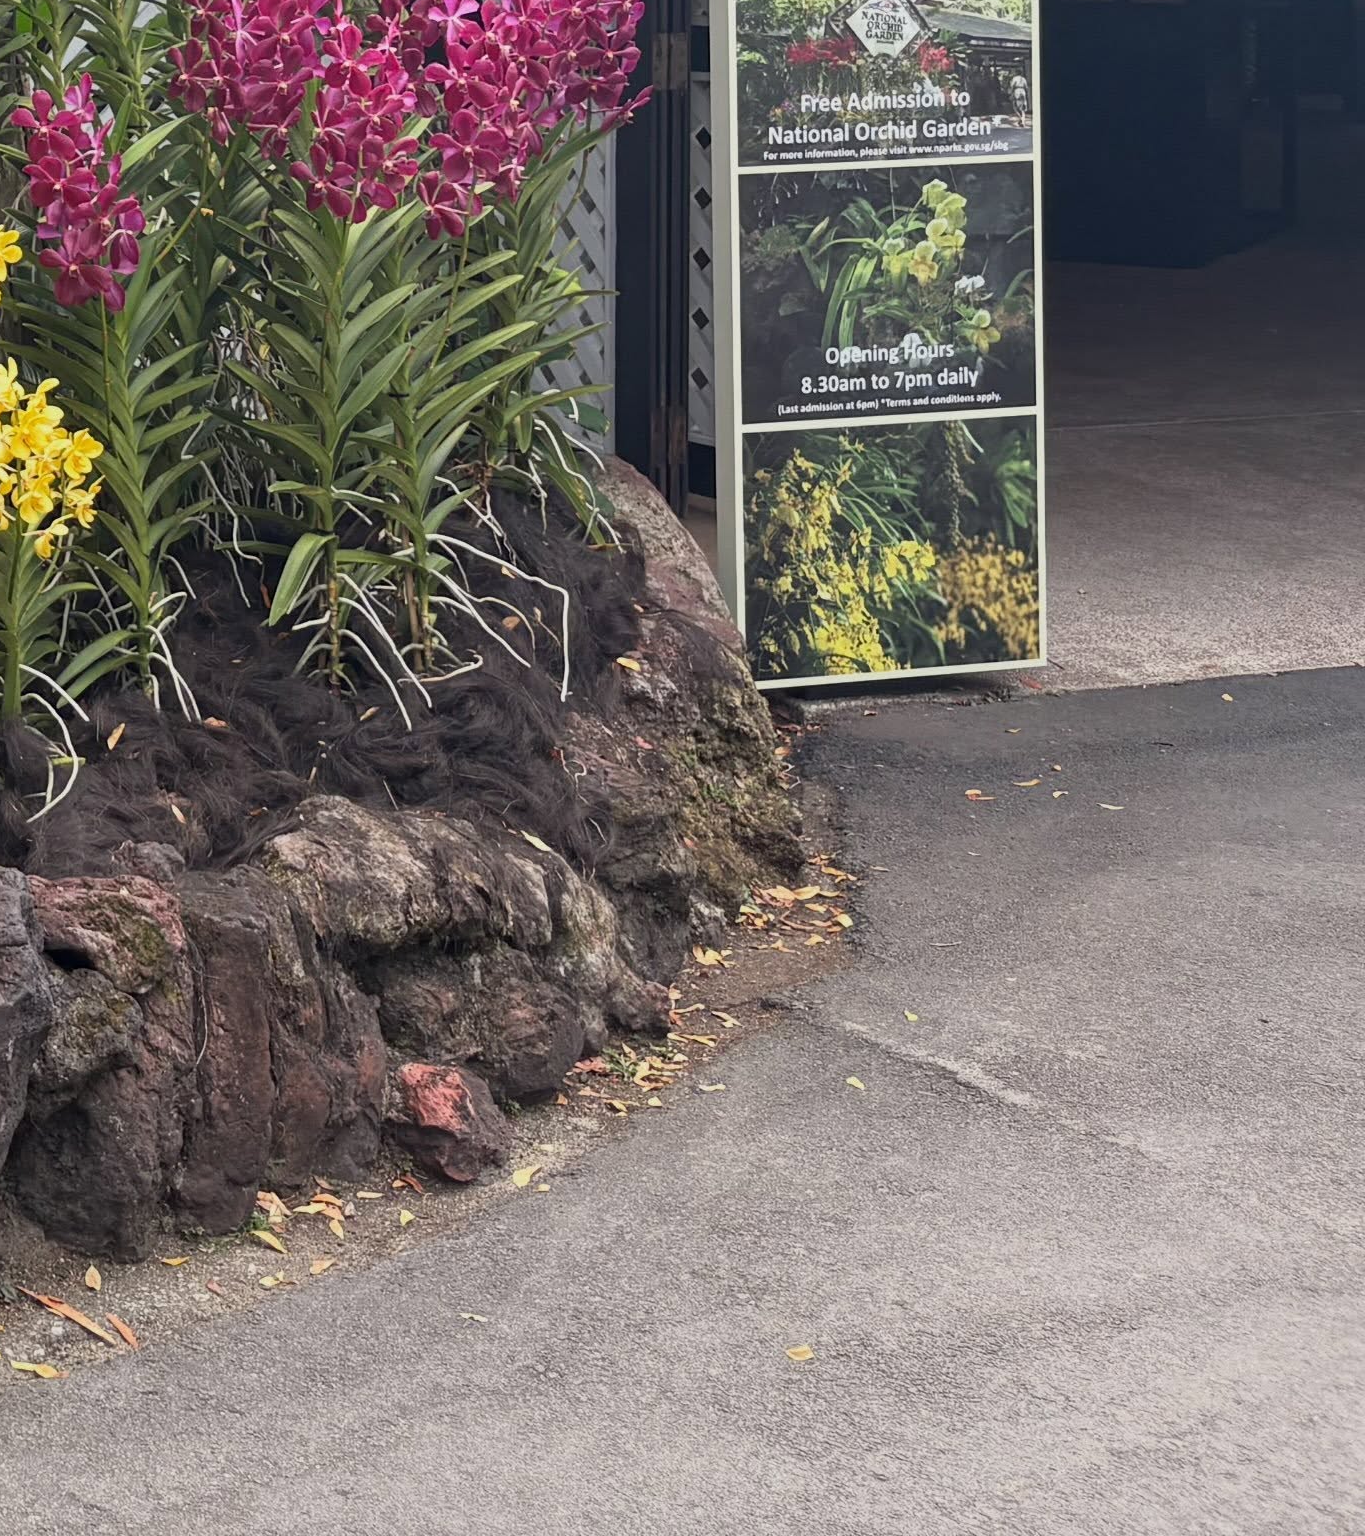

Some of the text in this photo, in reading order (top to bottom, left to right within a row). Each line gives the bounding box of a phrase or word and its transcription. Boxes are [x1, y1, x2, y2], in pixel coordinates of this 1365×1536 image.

[862, 11, 907, 25] NATIONAL
[867, 21, 903, 32] ORCHID
[866, 30, 903, 41] GARDEN
[801, 89, 970, 112] Free Admission to
[769, 123, 849, 145] National
[855, 120, 917, 141] Orchid
[764, 140, 1008, 160] For more information, please visit www.nparks.gov.sg/sbg
[825, 344, 955, 367] Opening Hours
[801, 366, 978, 394] 8.30am to 7pm daily
[778, 405, 798, 416] (Last
[800, 402, 844, 413] admission
[846, 401, 855, 410] at
[856, 399, 879, 411] 6pm)
[913, 396, 929, 406] and
[931, 393, 974, 405] conditions
[976, 391, 1001, 403] apply.
